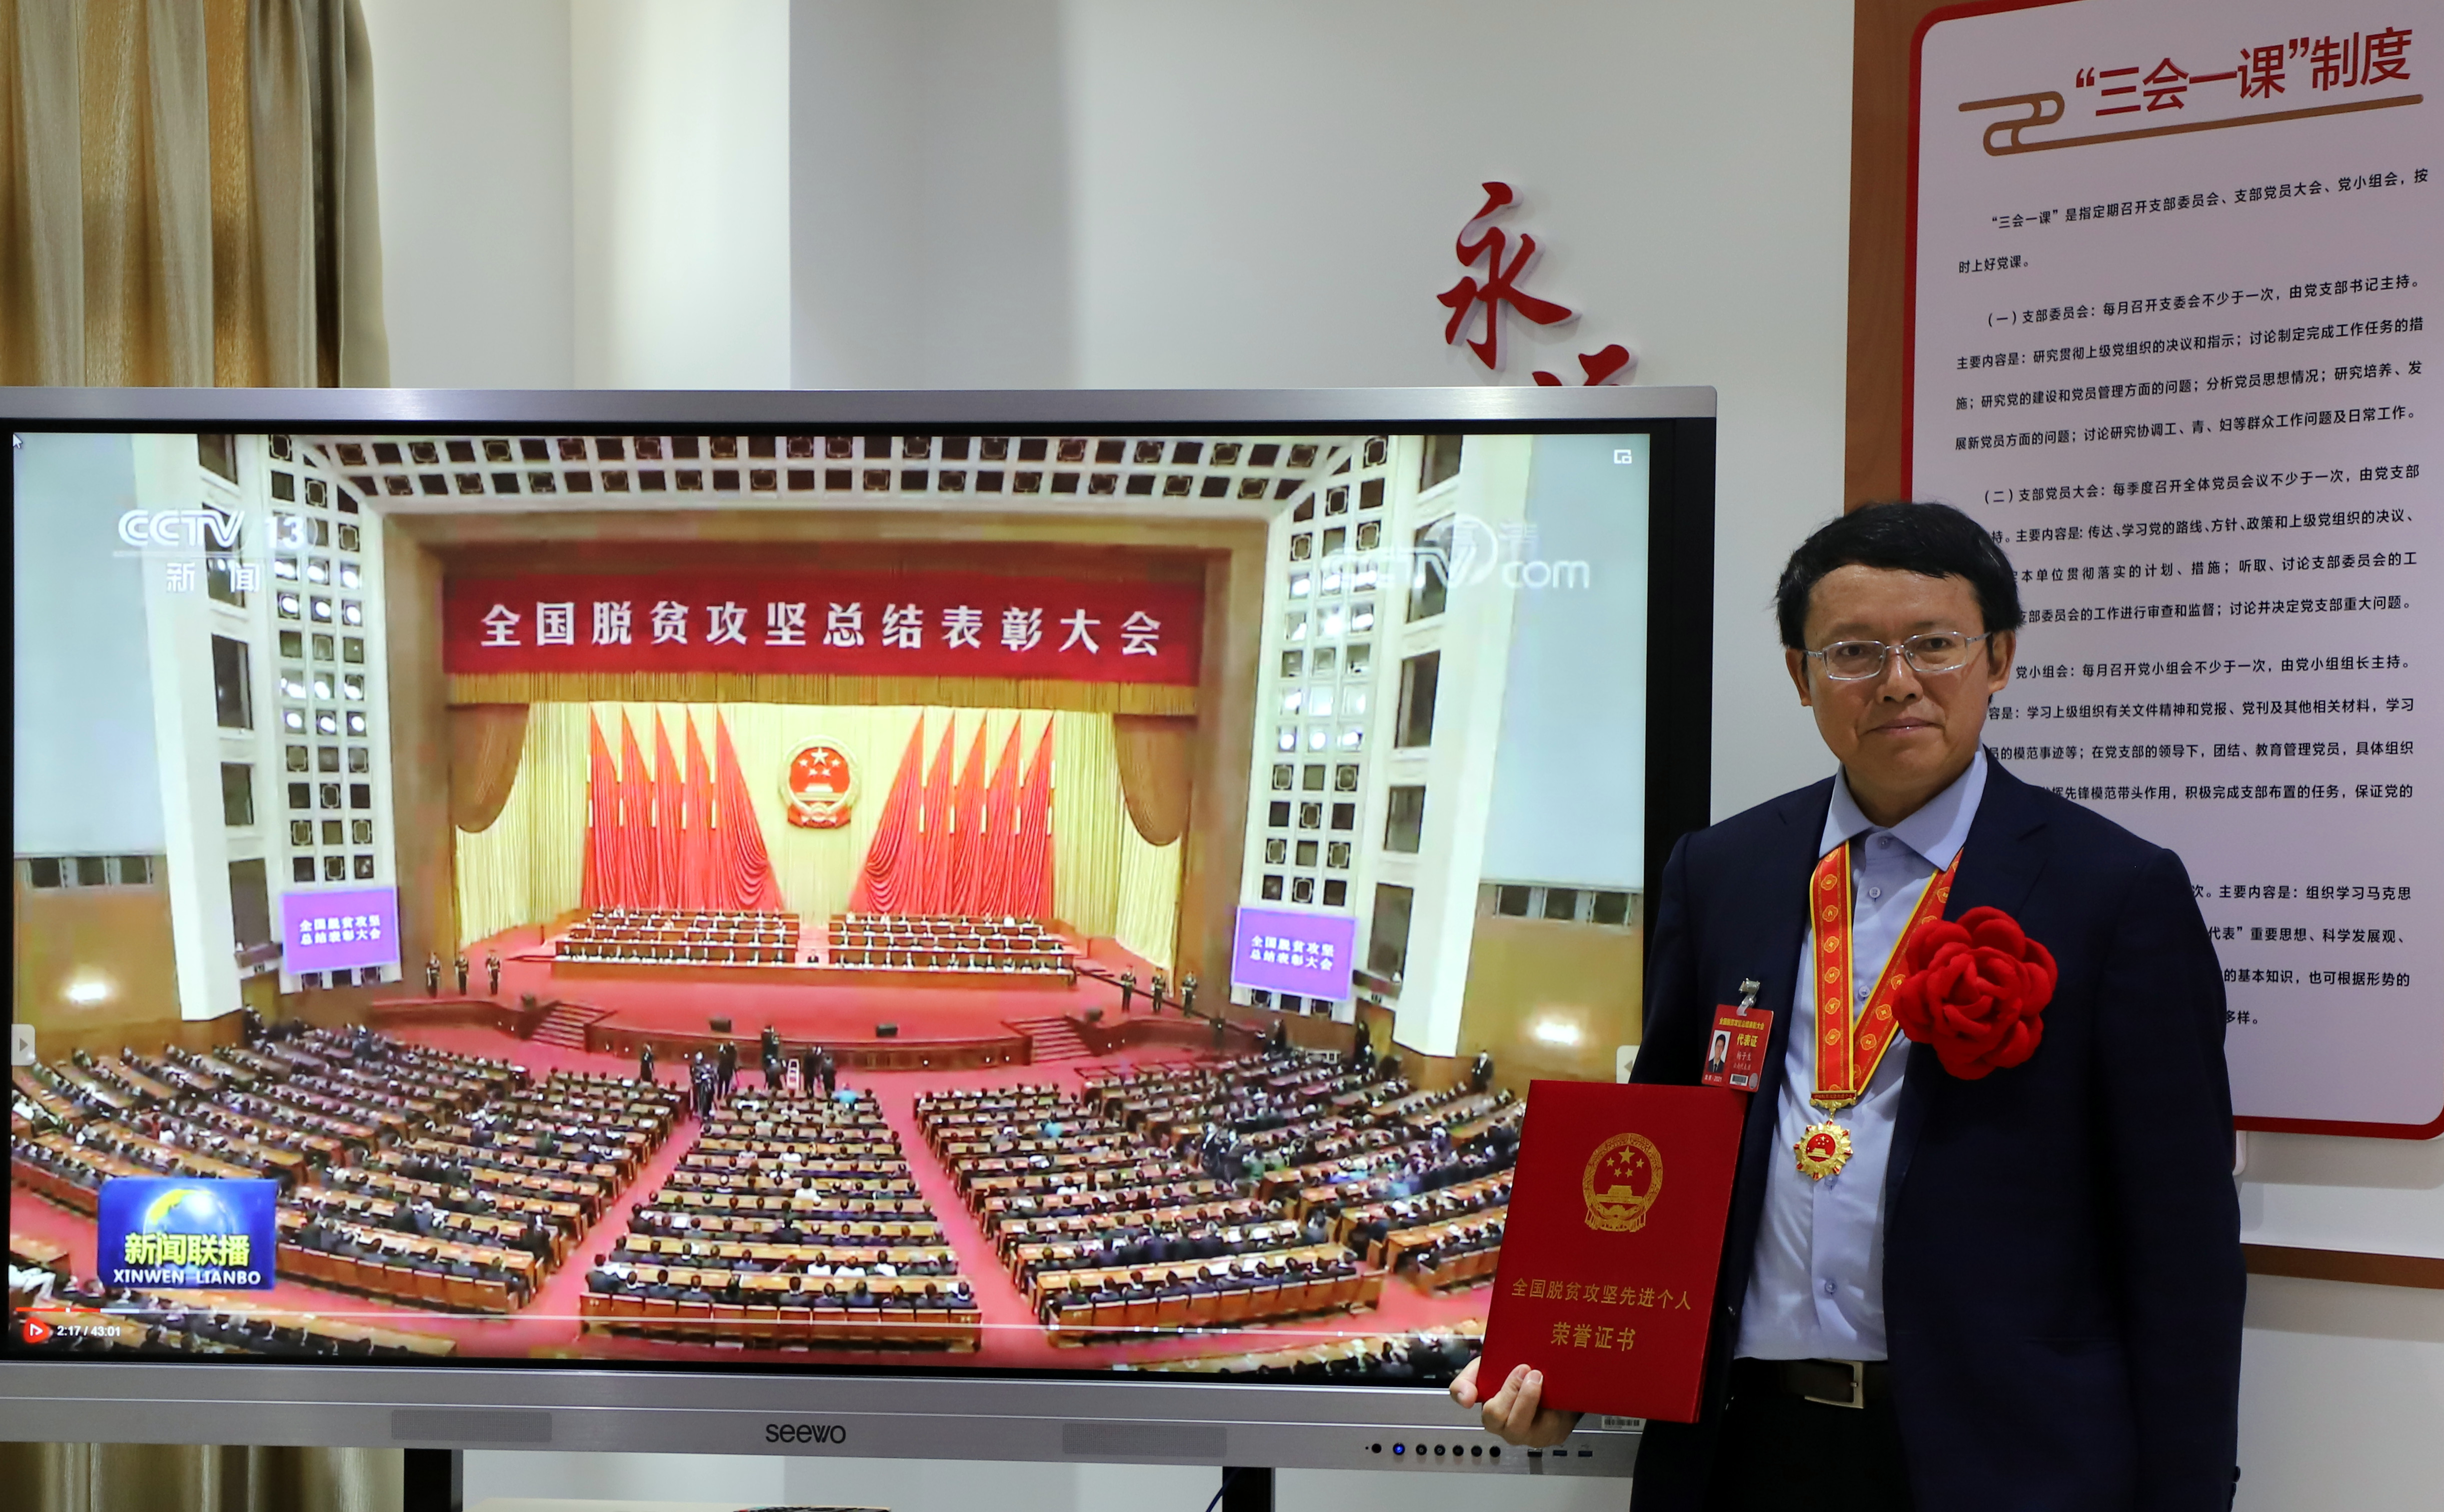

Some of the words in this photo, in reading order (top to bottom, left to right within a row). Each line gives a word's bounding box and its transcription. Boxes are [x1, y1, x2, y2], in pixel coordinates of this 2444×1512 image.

[2075, 26, 2412, 116] “三会一课”制度
[1991, 168, 2428, 229] “三会一课”是指定期召开支部委员会、支部党员大会、党小组会，按
[1436, 182, 1575, 371] 永
[1958, 254, 2029, 274] 时上好党课。
[1988, 274, 2418, 327] （一）支部委员会：每月召开支委会不少于一次，由党支部书记主持。
[1956, 316, 2423, 370] 主要内容是：研究贯彻上级党组织的决议和指示；讨论制定完成工作任务的措
[1955, 360, 2422, 410] 施；研究党的建设和党员管理方面的问题；分析党员思想情况；研究培养、发
[1955, 404, 2415, 450] 展新党员方面的问题；讨论研究协调工、青、妇等群众工作问题及日常工作。
[1984, 464, 2419, 504] （二）支部党员大会：每季度召开全体党员会议不少于一次，由党支部
[118, 509, 245, 548] CCTV
[264, 516, 307, 548] 13
[166, 562, 261, 593] 新闻
[480, 600, 1162, 656] 全国脱贫攻坚总结表彰大会
[2015, 654, 2409, 679] 党小组会：每月召开党小组会不少于一次，由党小组组长主持。
[2043, 784, 2413, 800] 挥先锋模范带头作用，积极完成支部布置的任务，保证党的
[2224, 968, 2410, 987] 的基本知识，也可根据形势的
[1737, 1033, 1758, 1048] 代表证
[125, 1232, 251, 1266] 新闻联播
[113, 1268, 185, 1284] XINWEN
[196, 1270, 261, 1284] LIANBO
[1511, 1278, 1691, 1310] 全国脱贫攻坚先进个人
[57, 1324, 81, 1337] 2:17
[90, 1324, 121, 1337] 43:01
[1551, 1322, 1636, 1352] 荣誉证书
[766, 1424, 847, 1444] seewo
